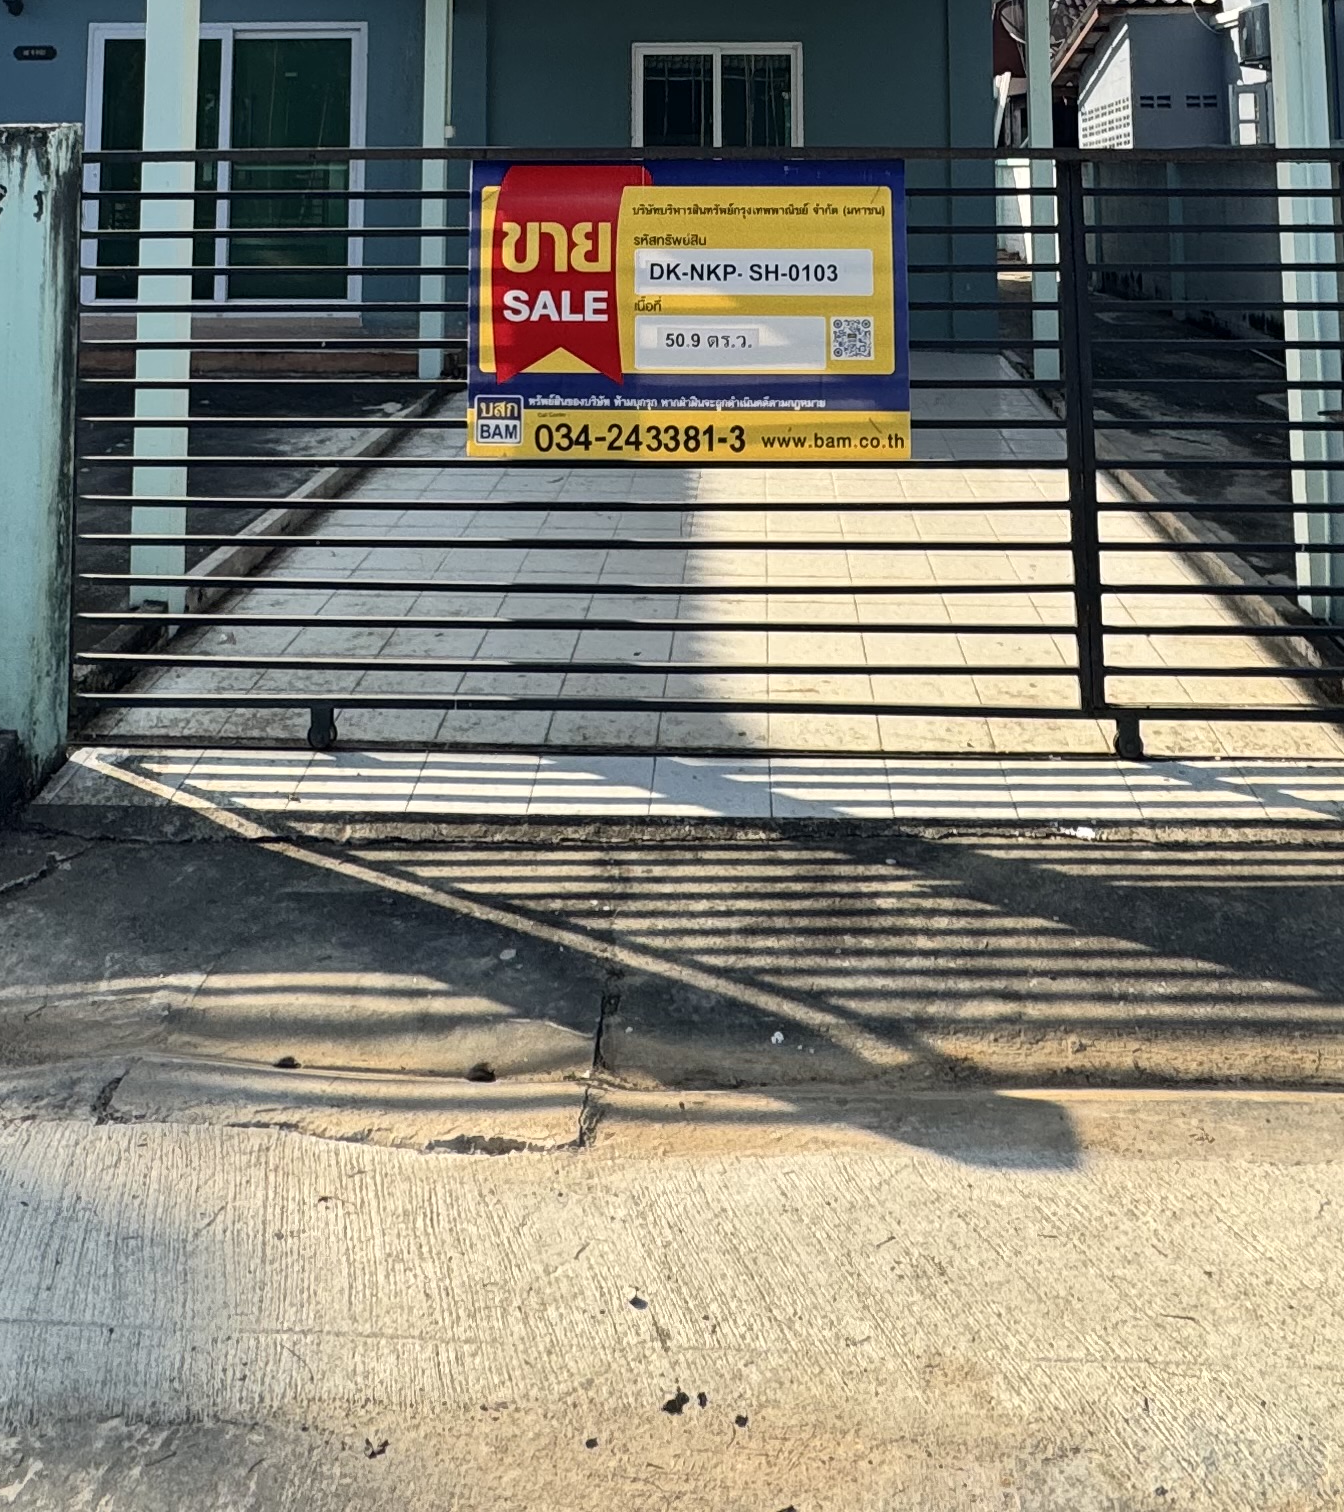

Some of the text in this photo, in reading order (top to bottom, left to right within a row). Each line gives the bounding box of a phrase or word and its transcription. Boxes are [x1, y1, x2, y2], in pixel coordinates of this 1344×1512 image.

[813, 203, 839, 216] จำกัด
[842, 205, 885, 217] (มหาชน)
[502, 221, 612, 273] ขาย
[633, 232, 707, 246] รหัสทรัพย์สิน
[748, 263, 838, 282] SH-0103
[503, 289, 609, 323] SALE
[633, 296, 662, 312] เนื้อที่
[665, 332, 753, 349] 50.9 ตร.ว.
[480, 400, 519, 418] บสก
[480, 423, 518, 440] BAM
[534, 423, 905, 453] 034-243381-3 www.bam.co.th
